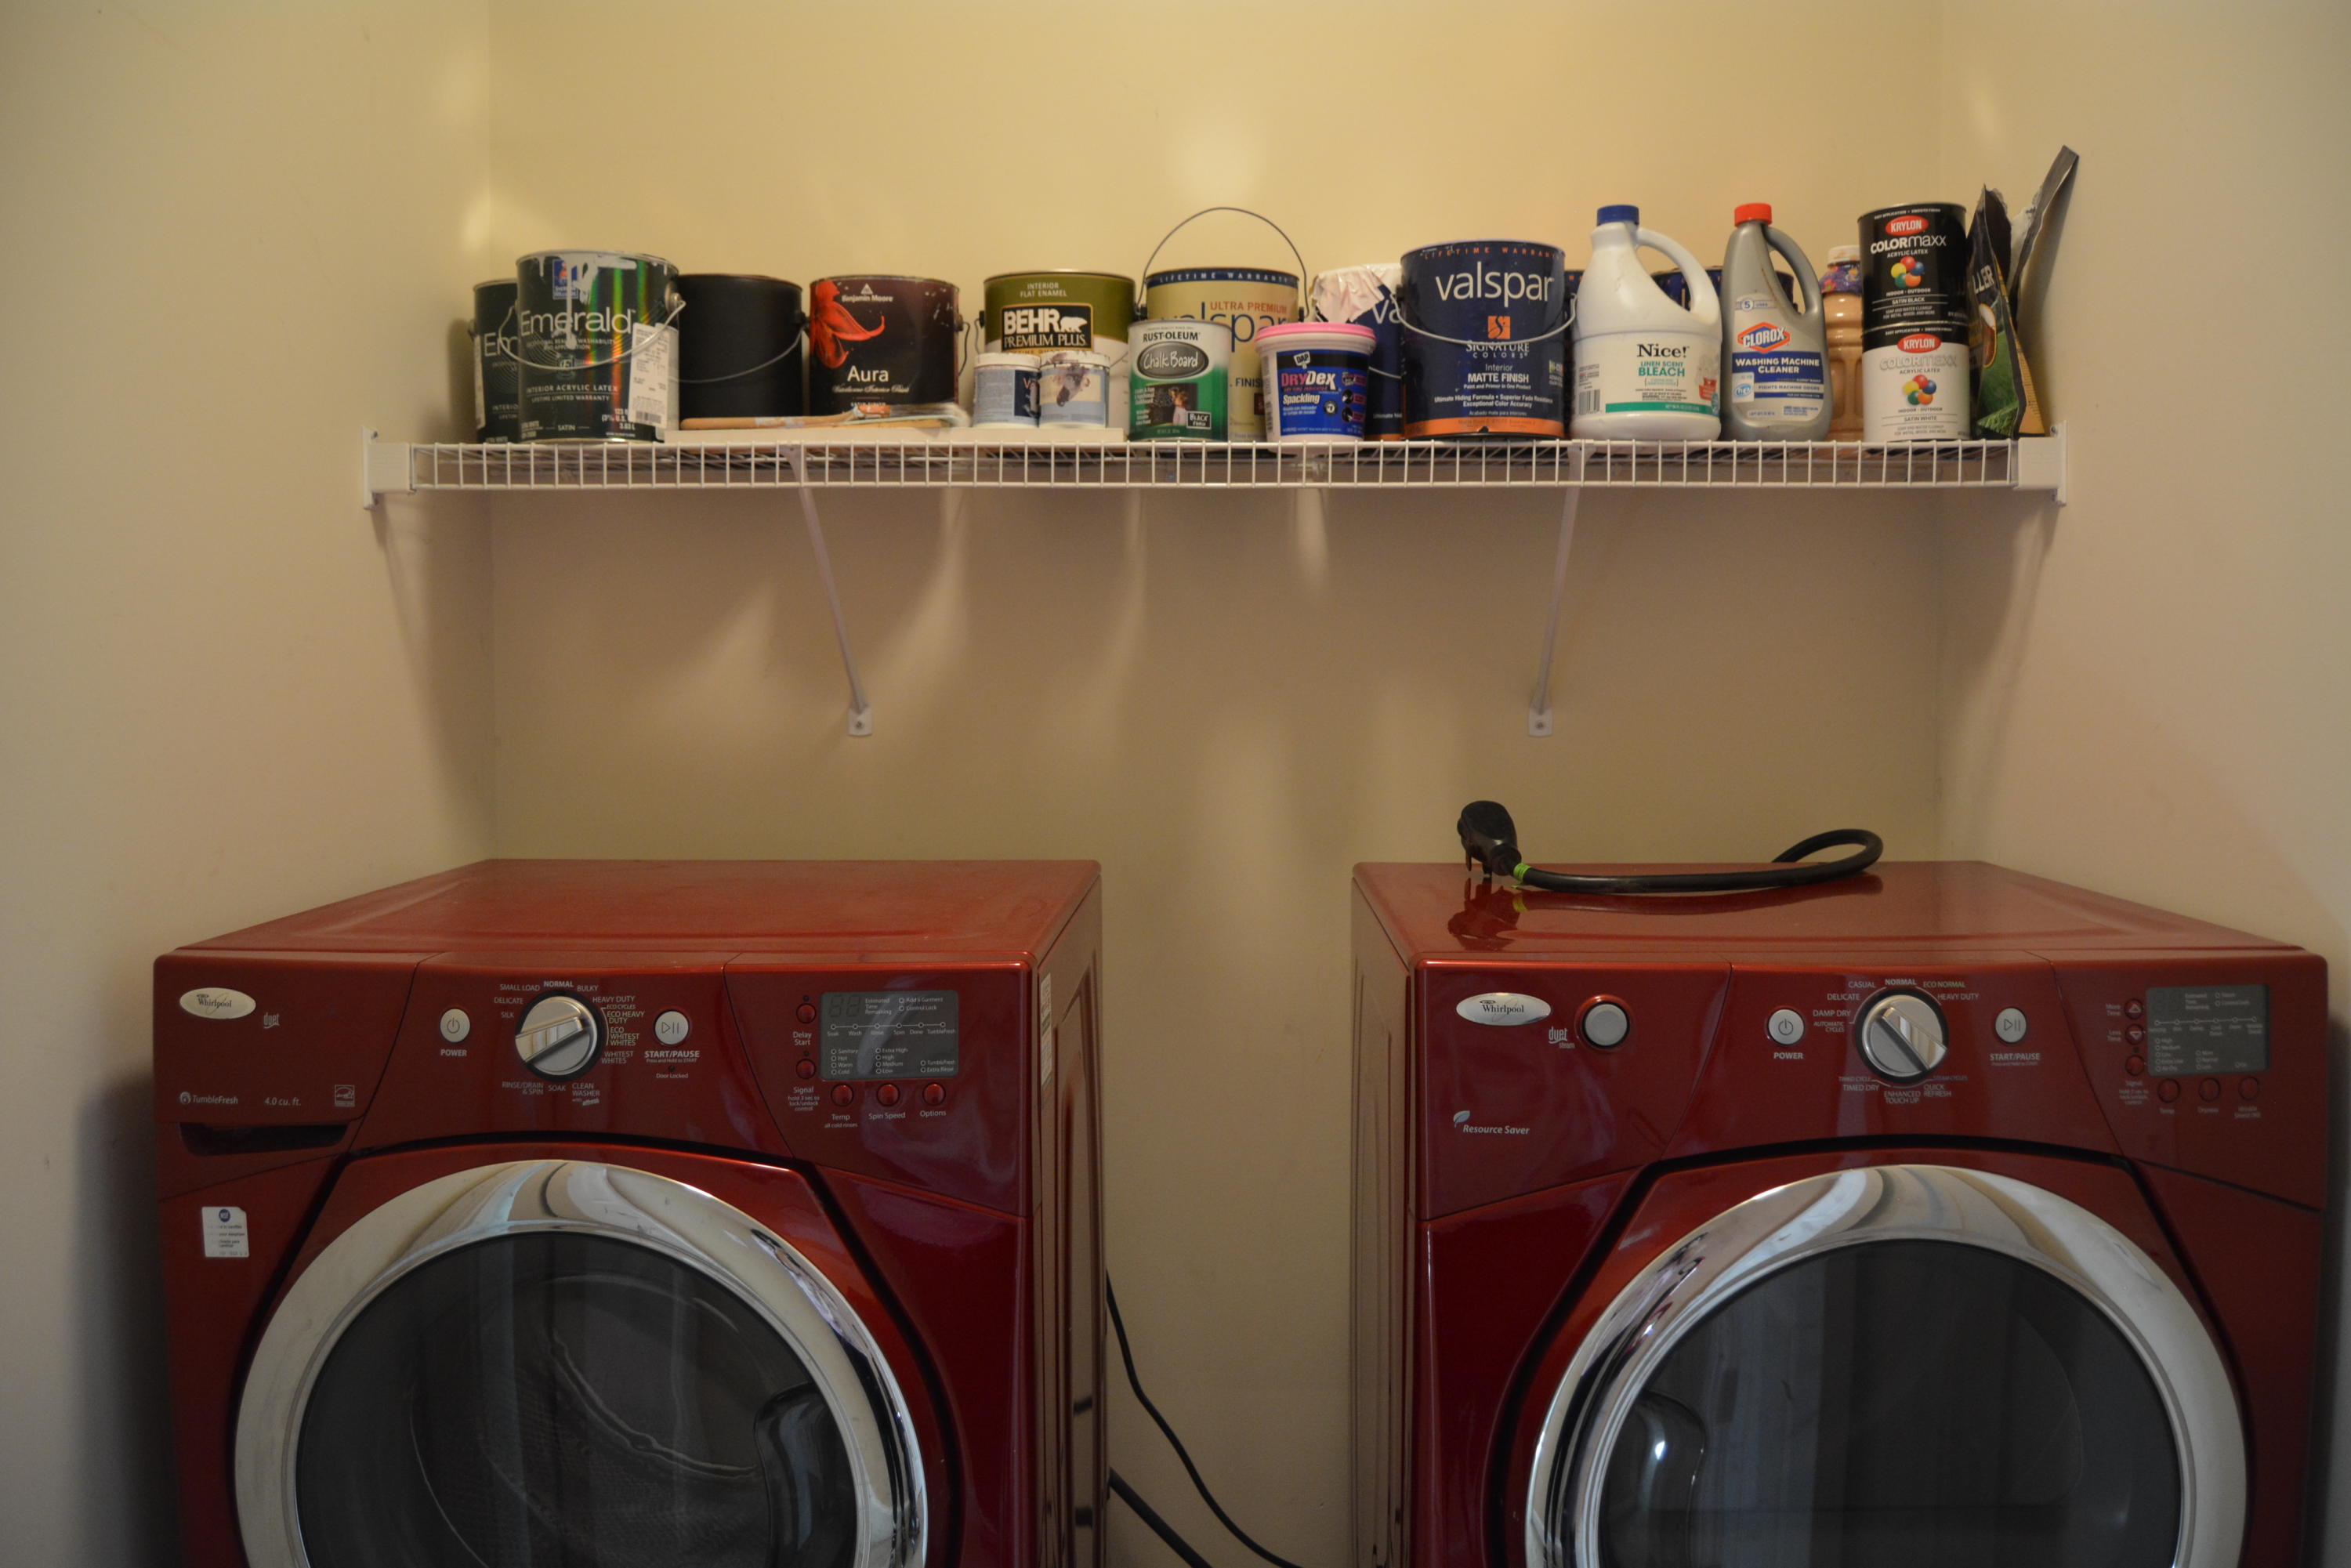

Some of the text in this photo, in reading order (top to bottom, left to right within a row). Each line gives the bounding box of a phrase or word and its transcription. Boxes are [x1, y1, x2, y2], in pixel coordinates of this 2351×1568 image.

[1890, 219, 1922, 233] KRYLON
[1424, 247, 1556, 260] LIFETIME WARRANT
[1886, 249, 1911, 259] ACRYLIC
[1159, 272, 1288, 284] LIFETIME WARRANTY
[1972, 265, 1995, 295] LLER
[1436, 261, 1553, 308] valspar
[1210, 301, 1288, 313] ULTRA PREMIUM
[520, 306, 632, 336] Emerald
[1004, 308, 1061, 335] BEHR
[1004, 334, 1087, 349] PREMIUM PLUS
[1742, 327, 1786, 348] CLOROX
[1465, 342, 1530, 353] SIGNATURE
[1903, 338, 1936, 349] KRYLON
[1636, 343, 1687, 358] Nice!
[1143, 350, 1198, 370] Chalk Board
[1295, 353, 1310, 364] DAP
[1735, 357, 1820, 367] WASHING MACHINE
[847, 365, 889, 382] Aura
[1485, 364, 1513, 372] Interior
[1638, 368, 1686, 377] BLEACH
[1235, 377, 1263, 387] FINIS
[1467, 373, 1530, 383] MATTE FINISH
[1282, 393, 1321, 406] Spackling
[1189, 413, 1208, 422] BLACK
[197, 998, 232, 1009] Whirlpool
[494, 996, 523, 1005] DELICATE
[1482, 1004, 1524, 1015] Whirlpool
[263, 1012, 280, 1027] duet
[792, 1031, 813, 1040] Delay
[1549, 1026, 1568, 1041] duet
[644, 1050, 700, 1059] START/PAUSE
[1990, 1053, 2041, 1062] START/PAUSE
[192, 1095, 238, 1104] TumbleFresh
[1884, 1090, 1921, 1099] ENHANCED
[264, 1097, 277, 1106] 4.0
[292, 1098, 301, 1106] ft.
[1462, 1124, 1531, 1135] Resource Saver
